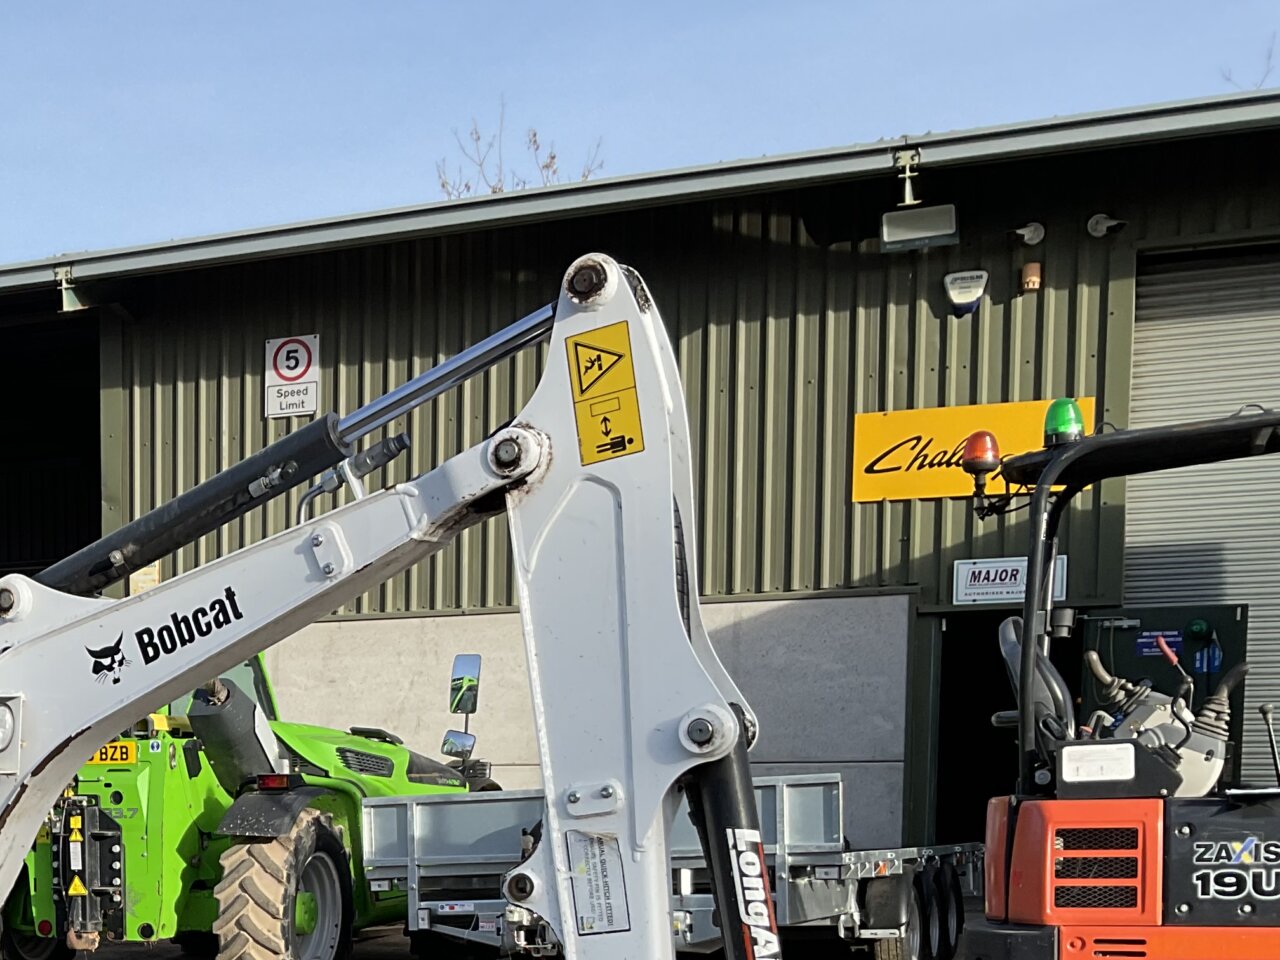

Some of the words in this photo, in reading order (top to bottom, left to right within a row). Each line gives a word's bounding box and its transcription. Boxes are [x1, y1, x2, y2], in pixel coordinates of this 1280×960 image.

[285, 348, 300, 371] 5
[276, 386, 309, 399] Speed
[279, 400, 305, 411] Limit
[969, 568, 1020, 583] MAJOR
[135, 586, 244, 665] Bobcat
[99, 745, 129, 762] BZB
[1193, 837, 1280, 865] ZAXIS
[1193, 868, 1280, 900] 19U
